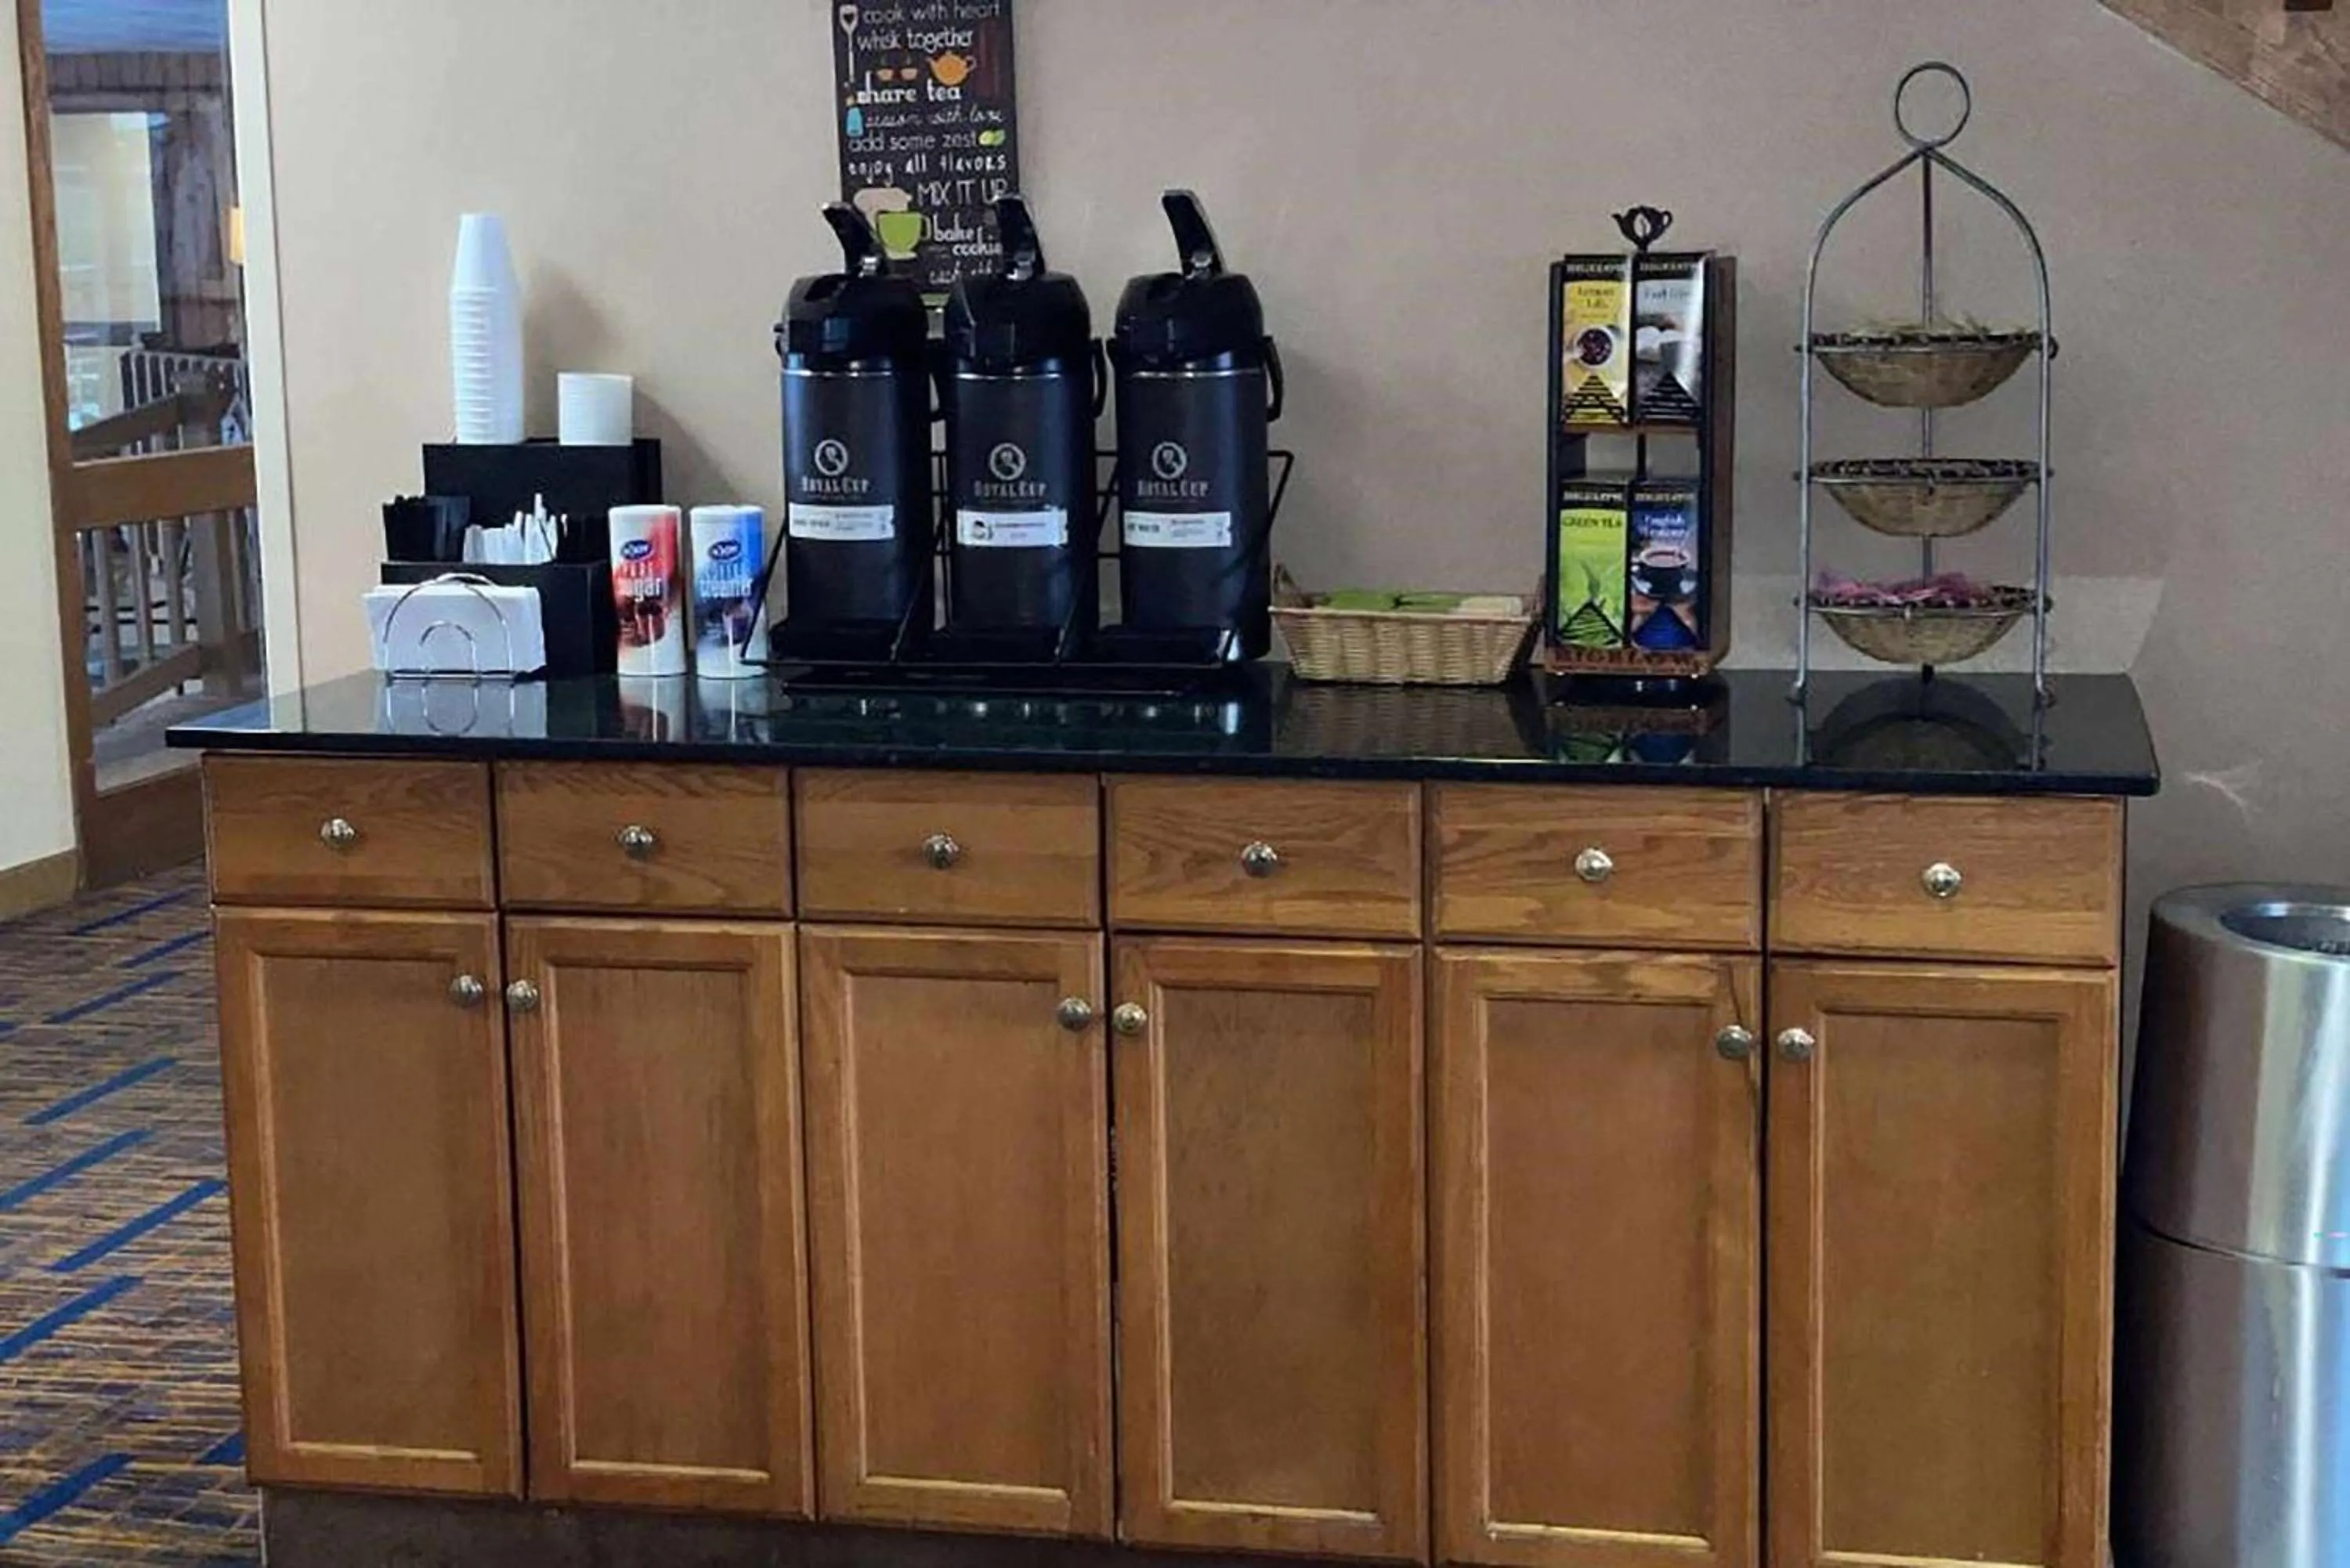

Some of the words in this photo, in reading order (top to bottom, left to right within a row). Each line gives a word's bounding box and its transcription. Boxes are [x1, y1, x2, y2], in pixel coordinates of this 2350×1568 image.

[864, 2, 905, 23] cook
[912, 2, 949, 21] with
[906, 27, 974, 52] together
[856, 70, 917, 104] share
[927, 78, 961, 102] tea
[849, 128, 884, 152] add
[890, 136, 935, 150] some
[942, 131, 978, 148] zest
[848, 161, 893, 185] enjoy
[906, 153, 927, 174] all
[917, 180, 952, 206] MIX
[956, 179, 976, 204] IT
[981, 179, 1008, 204] UP
